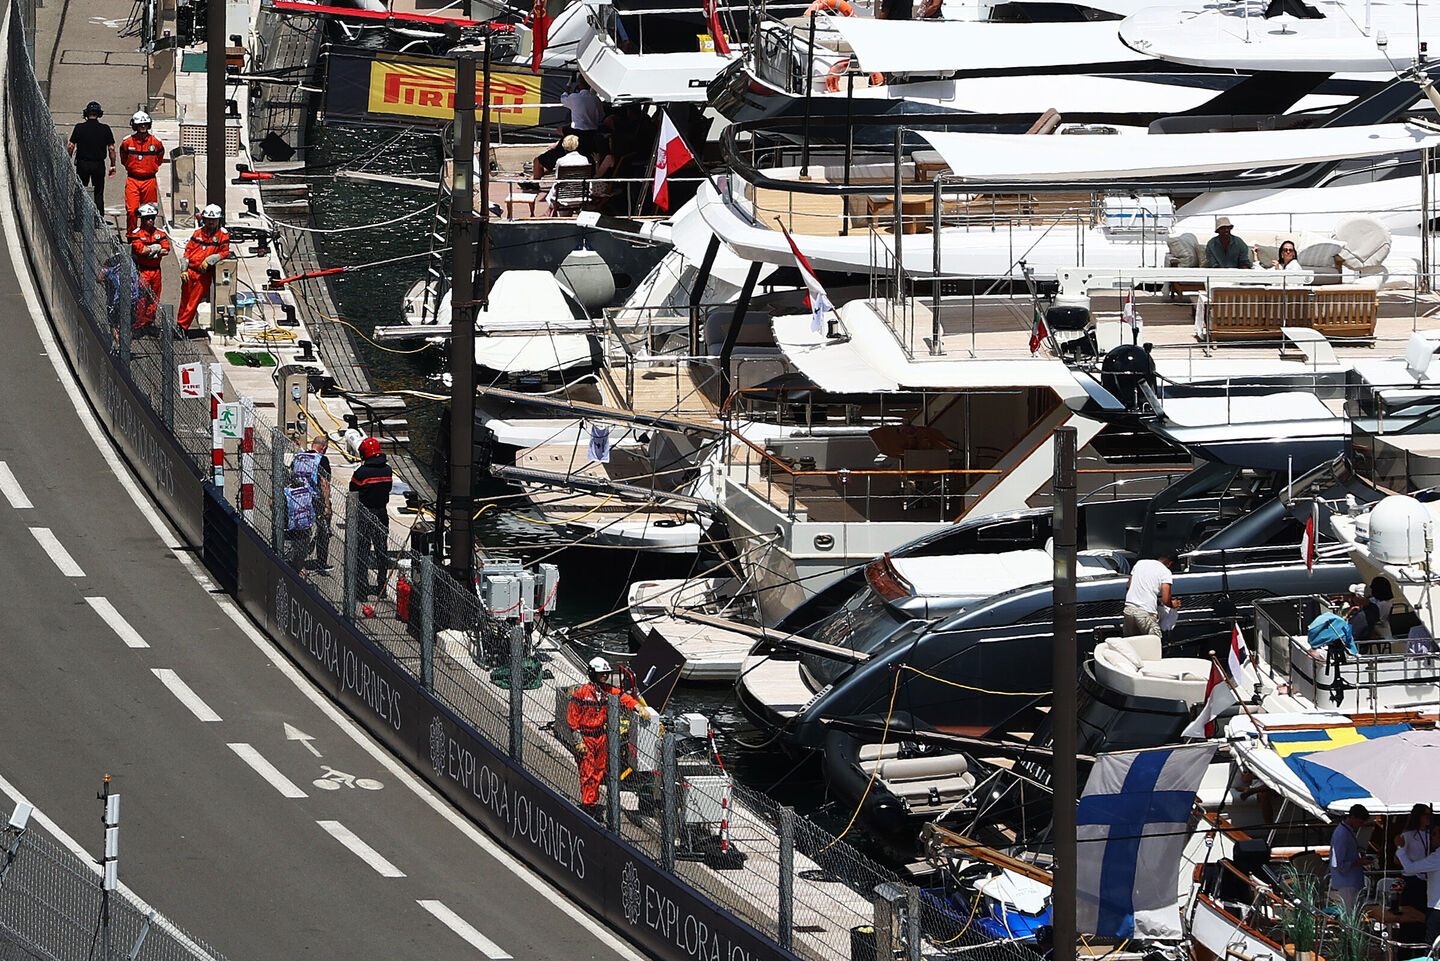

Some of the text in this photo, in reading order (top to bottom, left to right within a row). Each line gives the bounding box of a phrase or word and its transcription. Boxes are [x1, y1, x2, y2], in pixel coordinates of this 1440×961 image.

[290, 597, 401, 731] EXPLORA JOURNEYS
[448, 738, 586, 880] EXPLORA JOURNEYS
[645, 884, 720, 961] EXPLORA
